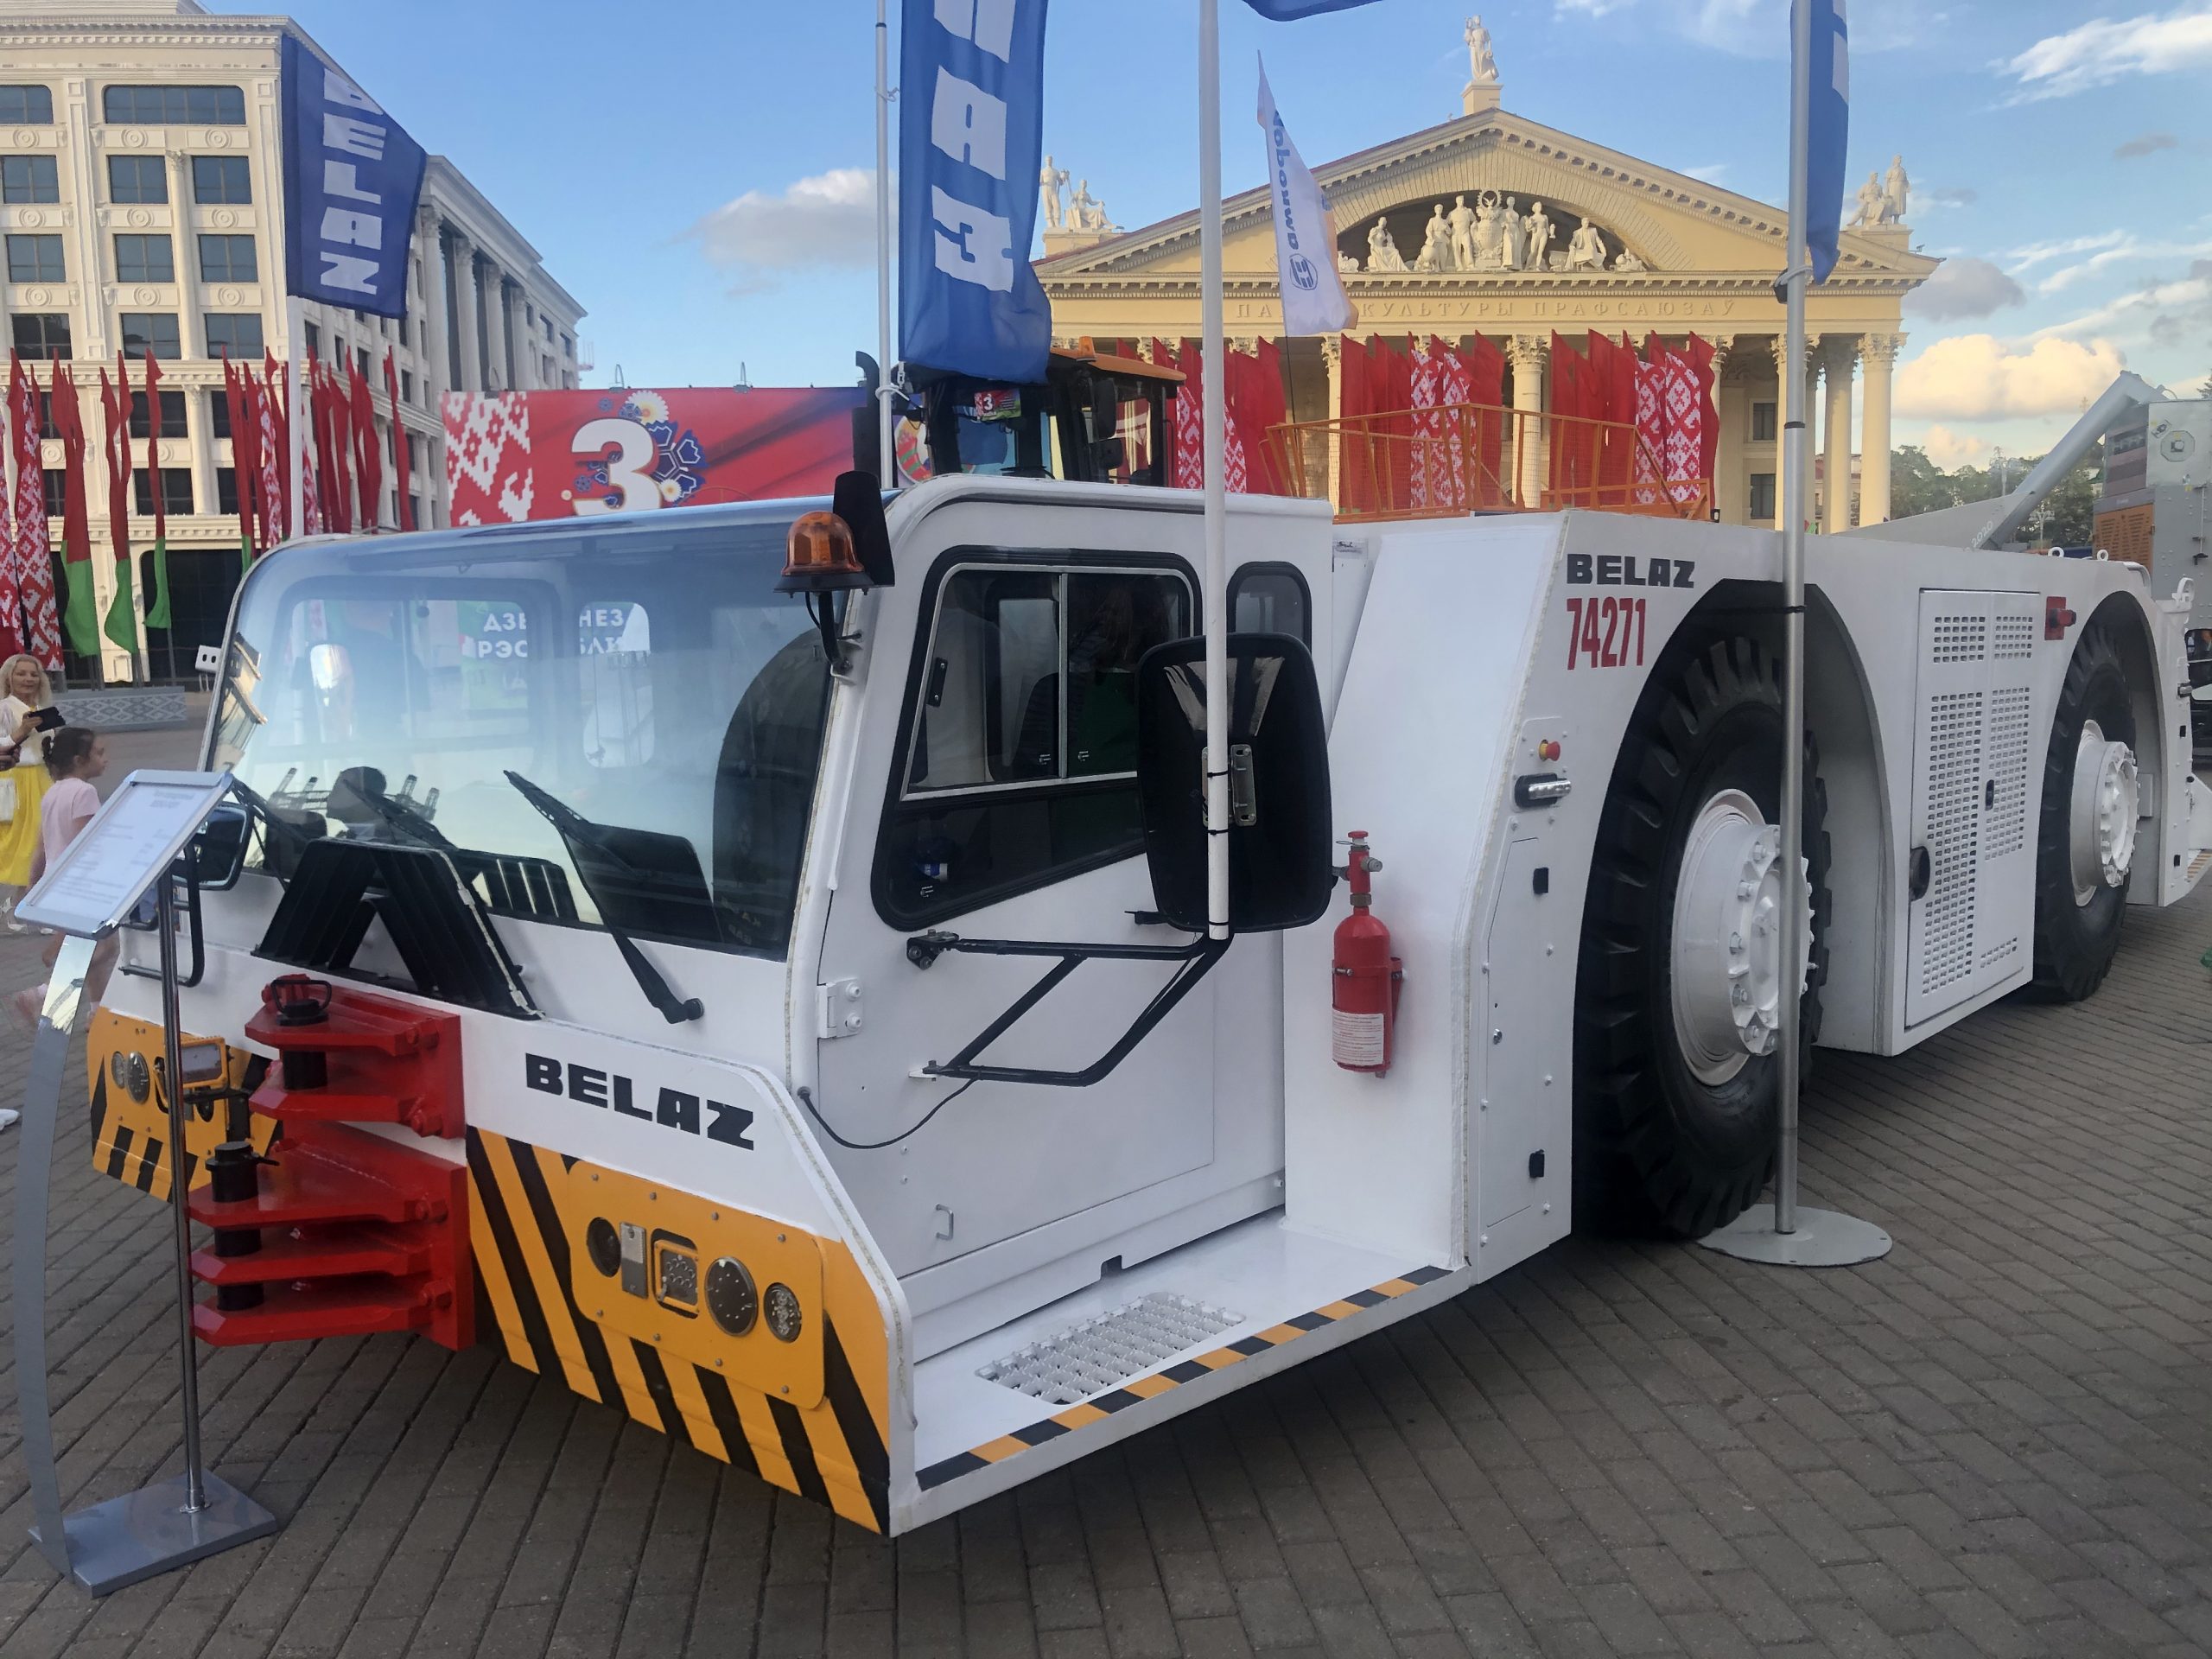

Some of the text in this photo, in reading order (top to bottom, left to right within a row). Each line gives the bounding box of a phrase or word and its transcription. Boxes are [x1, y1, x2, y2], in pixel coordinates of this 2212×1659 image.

[1361, 299, 1734, 318] КУЛЬТУРЫ ПРАФСАЮЗАЎ
[571, 418, 663, 516] 3
[1567, 553, 1695, 588] BELAZ
[1567, 596, 1646, 671] 74271
[525, 1052, 754, 1151] BELAZ
